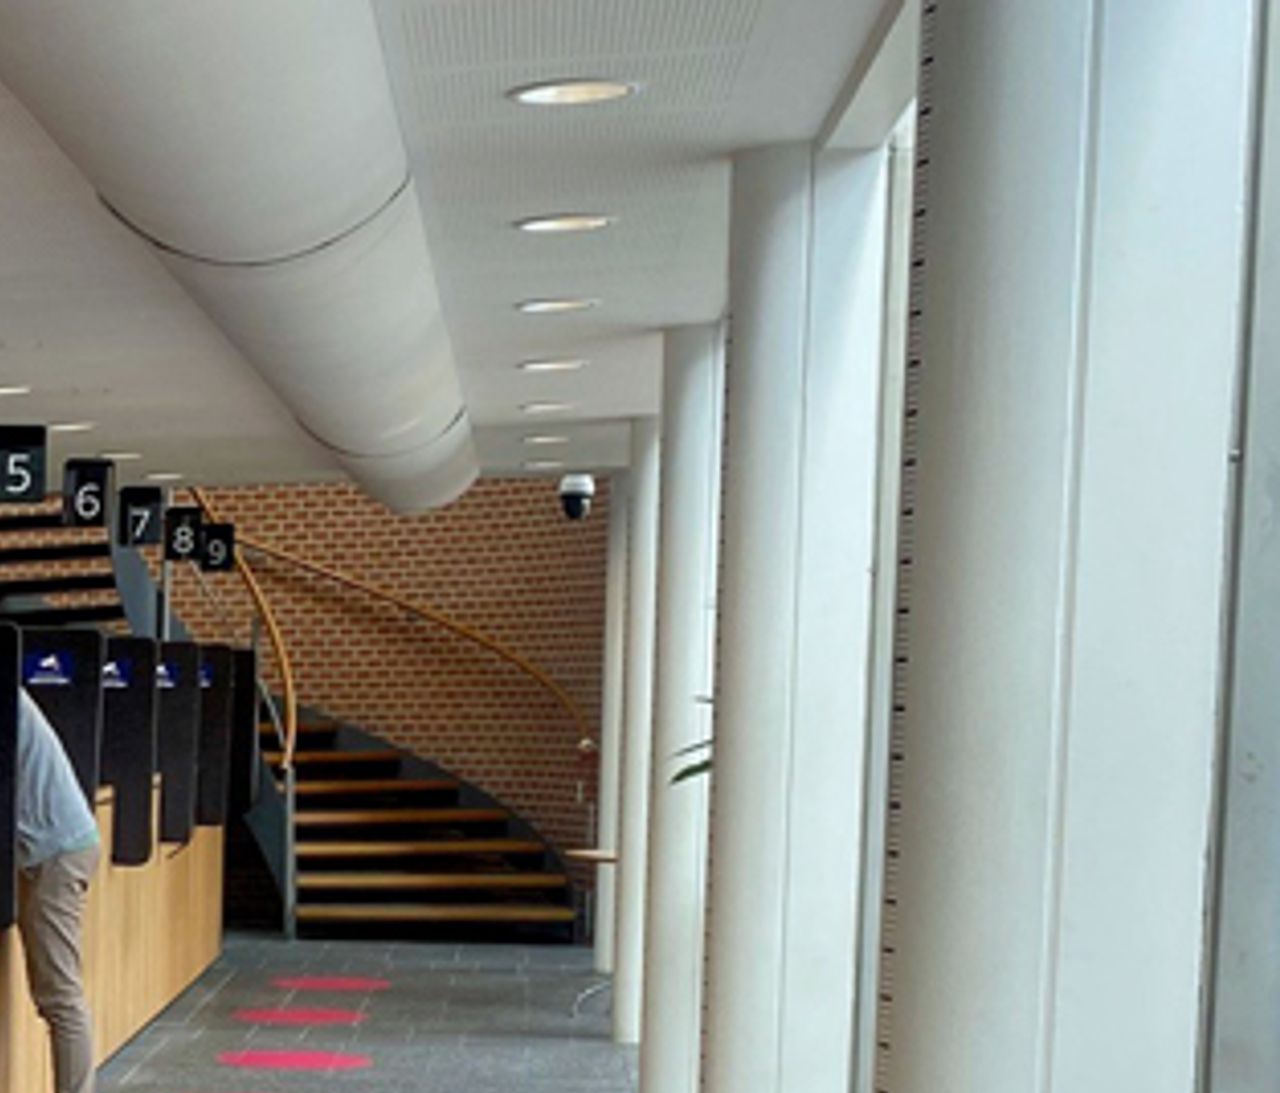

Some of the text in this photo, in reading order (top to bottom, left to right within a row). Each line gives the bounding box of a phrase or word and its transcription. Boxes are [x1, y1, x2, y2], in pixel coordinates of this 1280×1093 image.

[7, 454, 30, 492] 5
[76, 484, 99, 517] 6
[132, 510, 150, 536] 7
[174, 526, 193, 553] 8
[209, 540, 226, 564] 9
